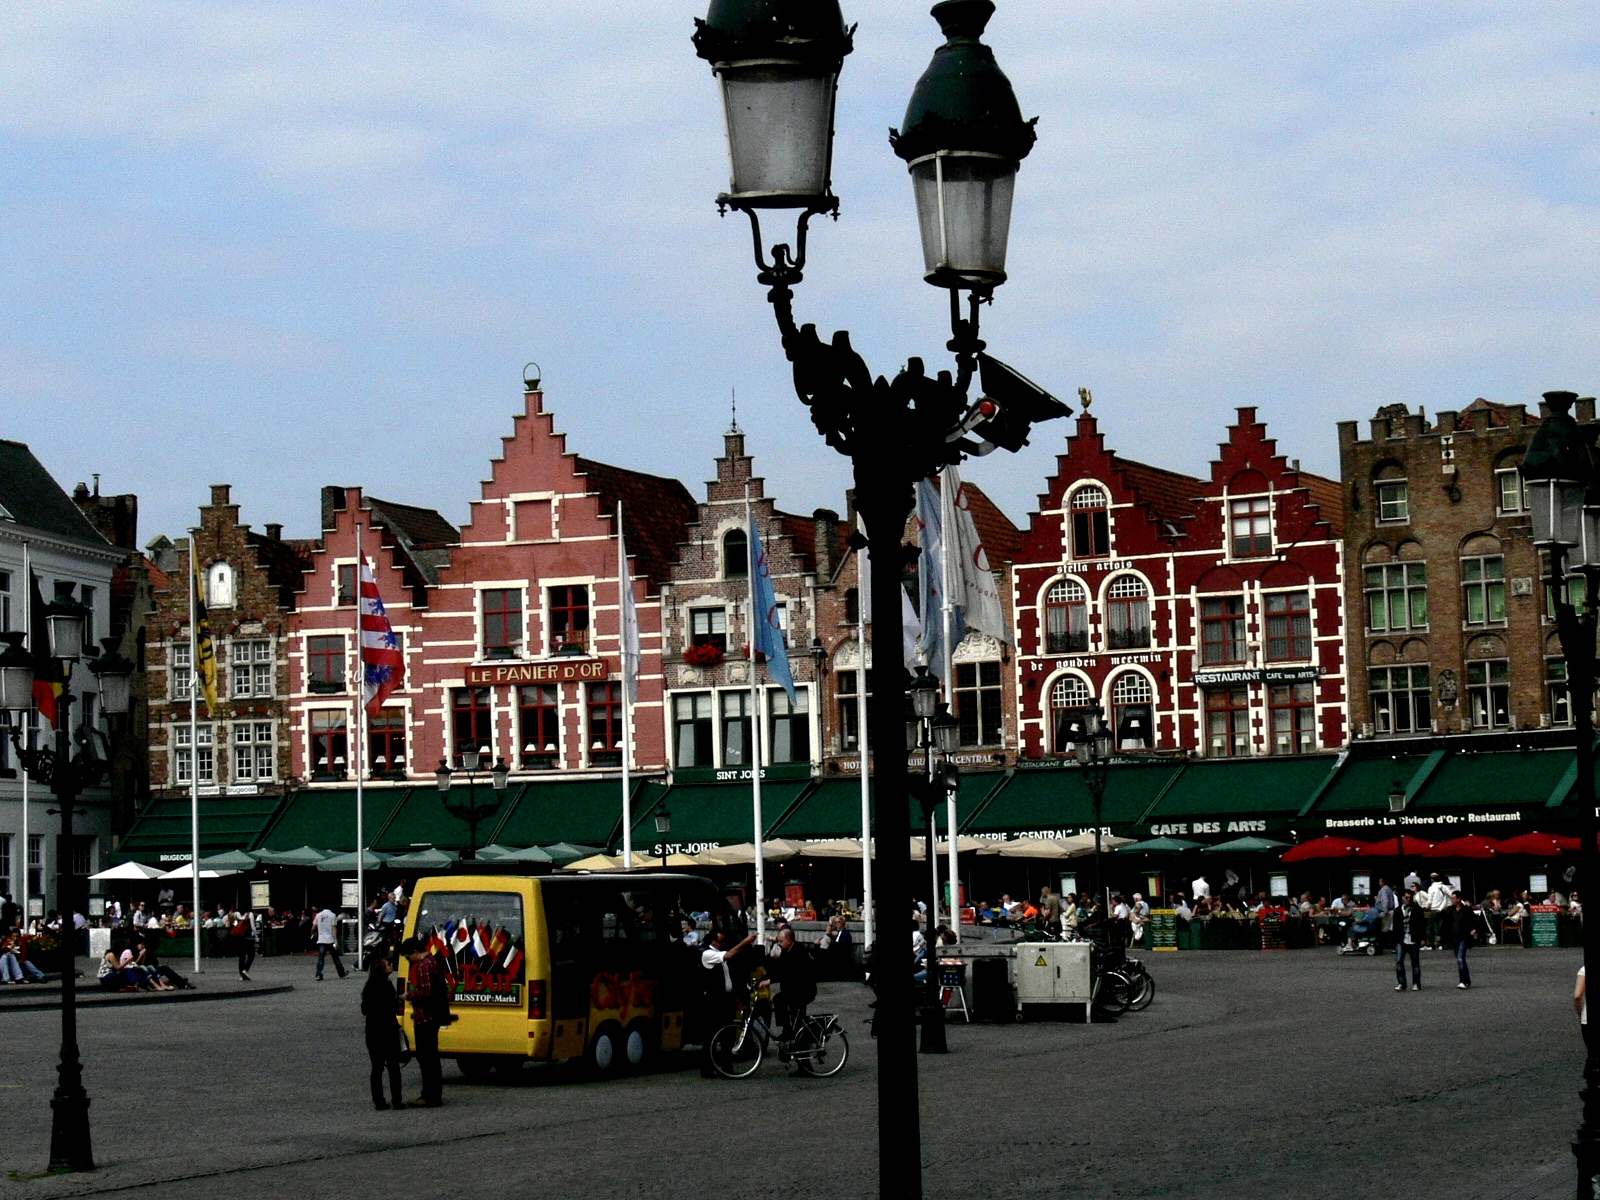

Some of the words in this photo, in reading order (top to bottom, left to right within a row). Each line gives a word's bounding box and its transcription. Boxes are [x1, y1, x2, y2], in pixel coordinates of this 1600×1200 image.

[1096, 560, 1133, 571] artois
[1110, 653, 1162, 665] meermin
[471, 671, 492, 683] LE
[496, 664, 559, 681] PANIER
[563, 662, 603, 678] D'OR
[1194, 671, 1260, 684] RESTAURANT
[1297, 671, 1315, 679] ARTS
[955, 754, 993, 764] CENTRAL
[716, 770, 738, 780] SINT
[1325, 817, 1375, 828] Brasserie
[1383, 817, 1397, 826] La
[1437, 814, 1458, 824] d'Or
[1468, 811, 1521, 823] Restaurant
[1150, 824, 1188, 836] CAFE
[1193, 822, 1221, 834] DES
[1227, 820, 1267, 832] ARTS
